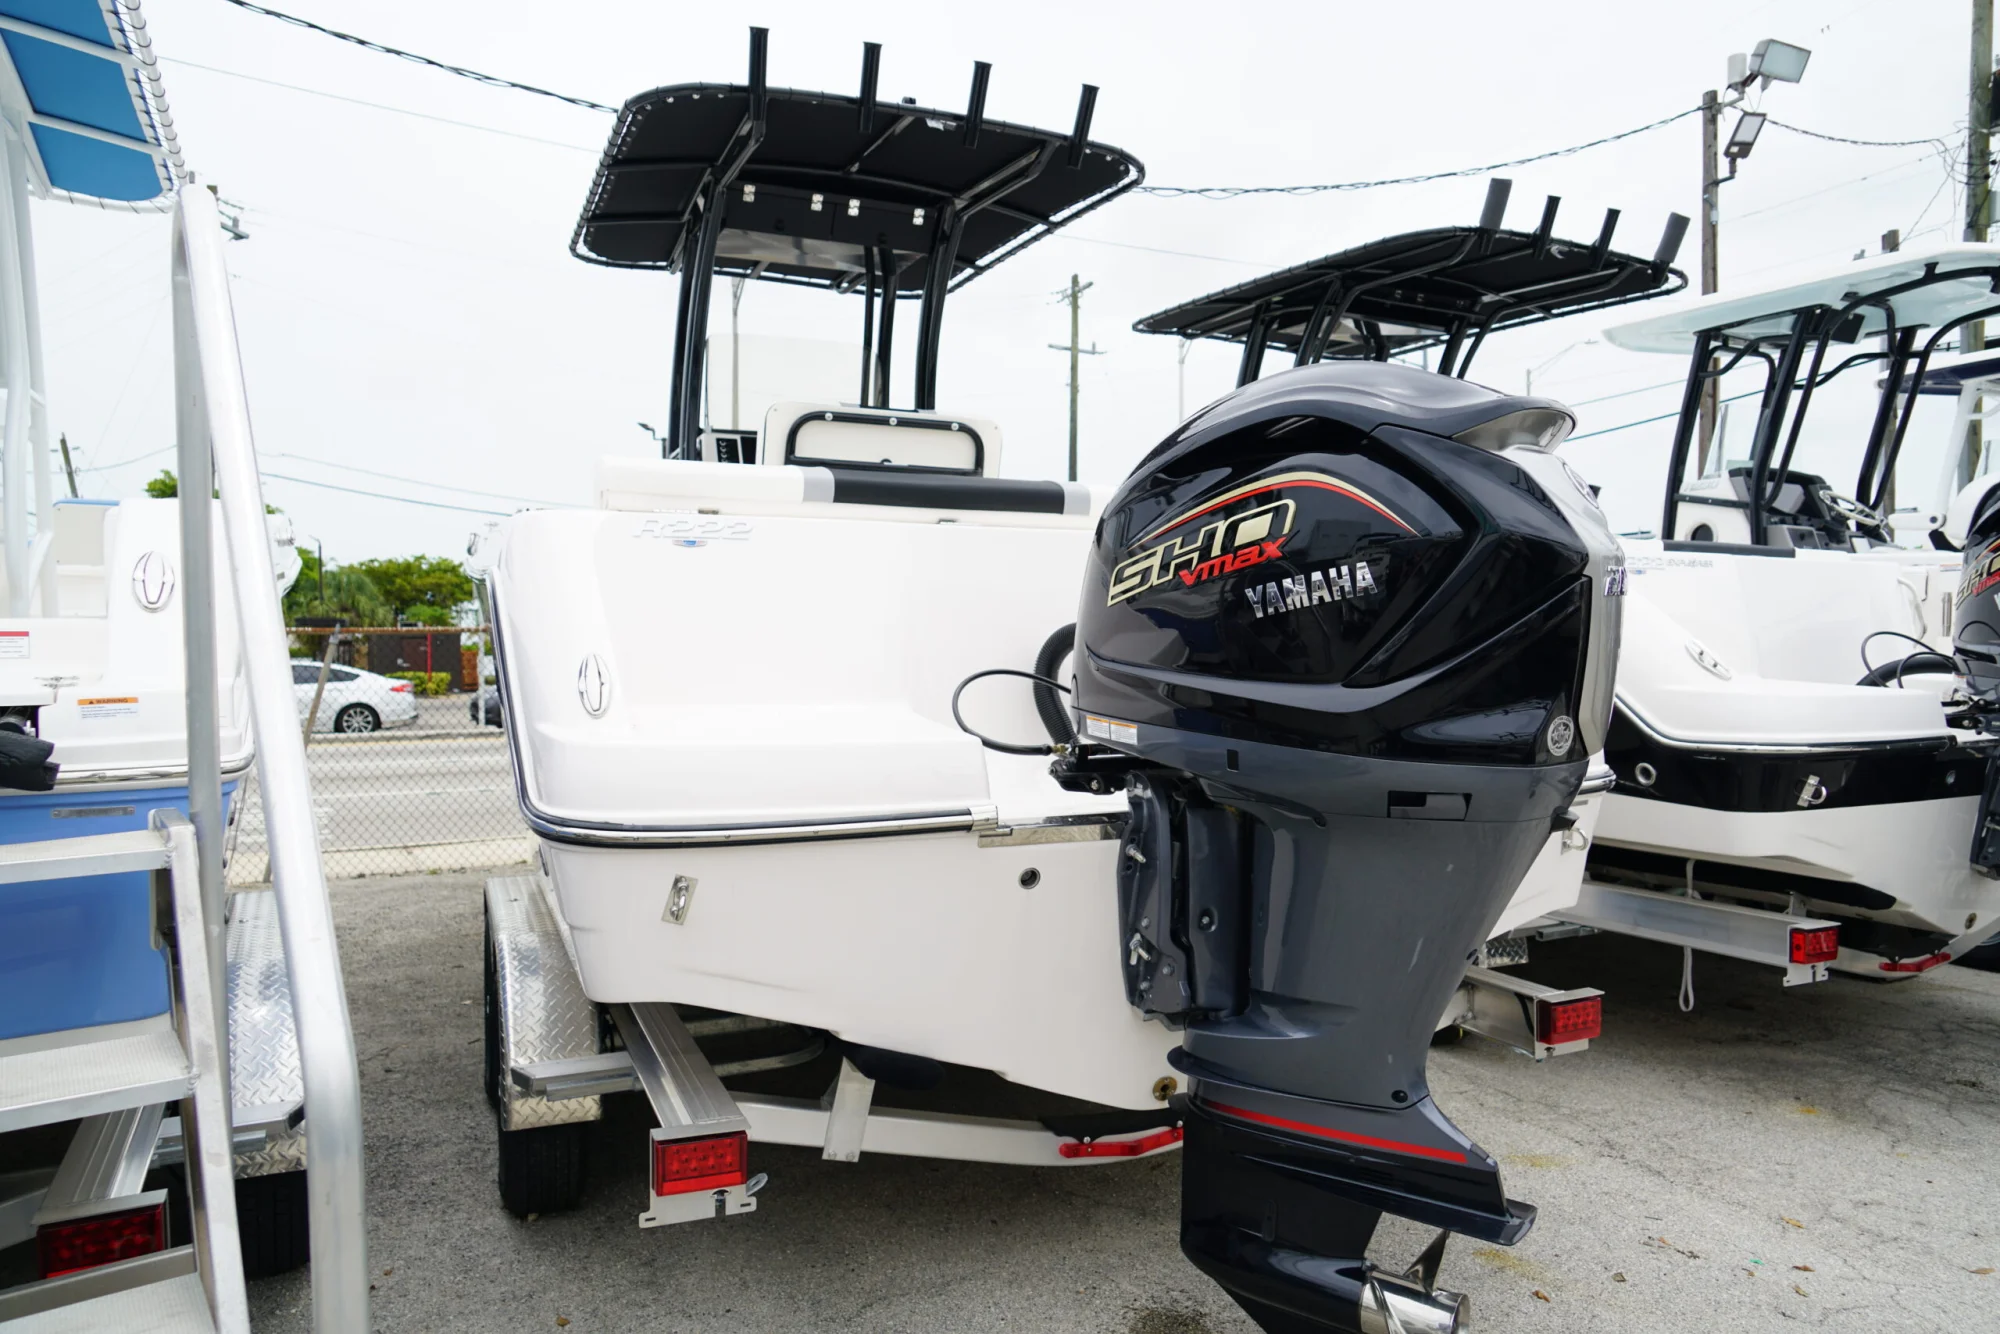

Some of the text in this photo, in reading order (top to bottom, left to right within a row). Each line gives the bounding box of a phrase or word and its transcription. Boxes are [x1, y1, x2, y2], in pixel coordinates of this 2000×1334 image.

[632, 519, 754, 540] R222
[1107, 499, 1296, 607] SHO
[1244, 561, 1378, 618] YAMAHA
